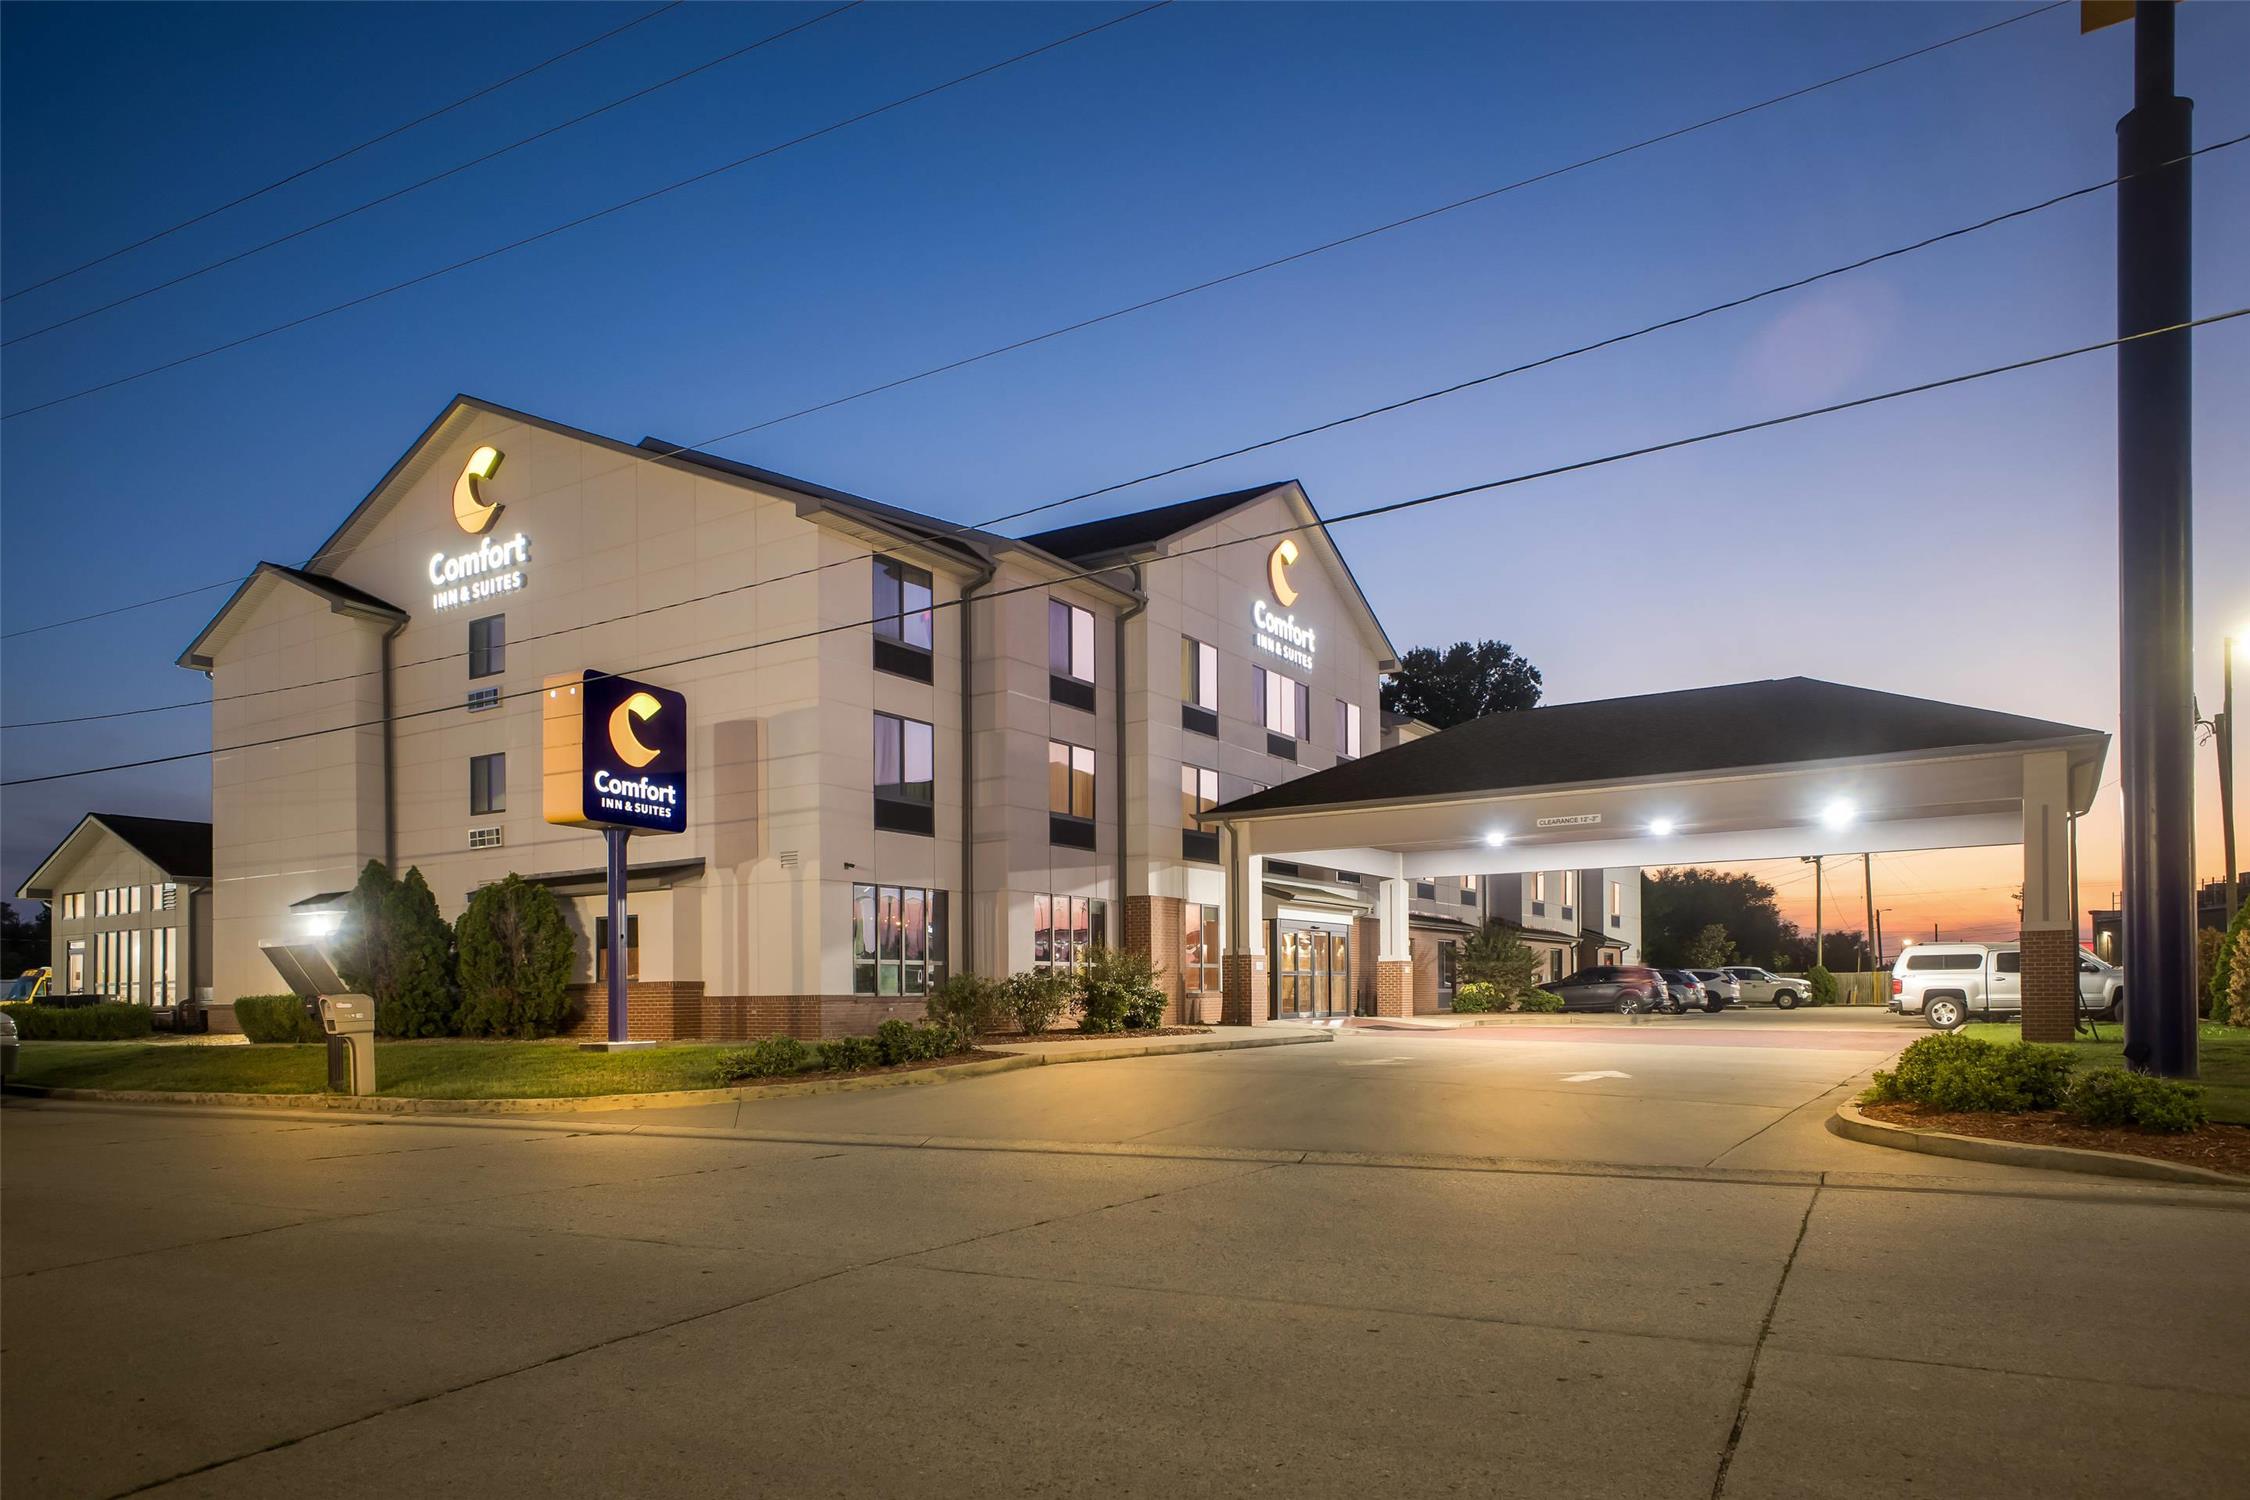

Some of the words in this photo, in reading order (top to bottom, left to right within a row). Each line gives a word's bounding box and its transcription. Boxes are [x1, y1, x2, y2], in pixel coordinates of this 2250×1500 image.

[429, 532, 527, 586] Comfort
[433, 588, 458, 610] INN
[460, 585, 471, 602] &
[472, 571, 521, 599] SUITES
[1254, 600, 1316, 653] Comfort
[1257, 633, 1275, 652] INN
[1275, 641, 1282, 656] &
[1283, 645, 1313, 669] SUITES
[594, 770, 676, 805] Comfort
[601, 797, 623, 810] INN
[624, 801, 633, 812] &
[634, 802, 672, 818] SUITES
[1539, 817, 1579, 826] CLEARANCE
